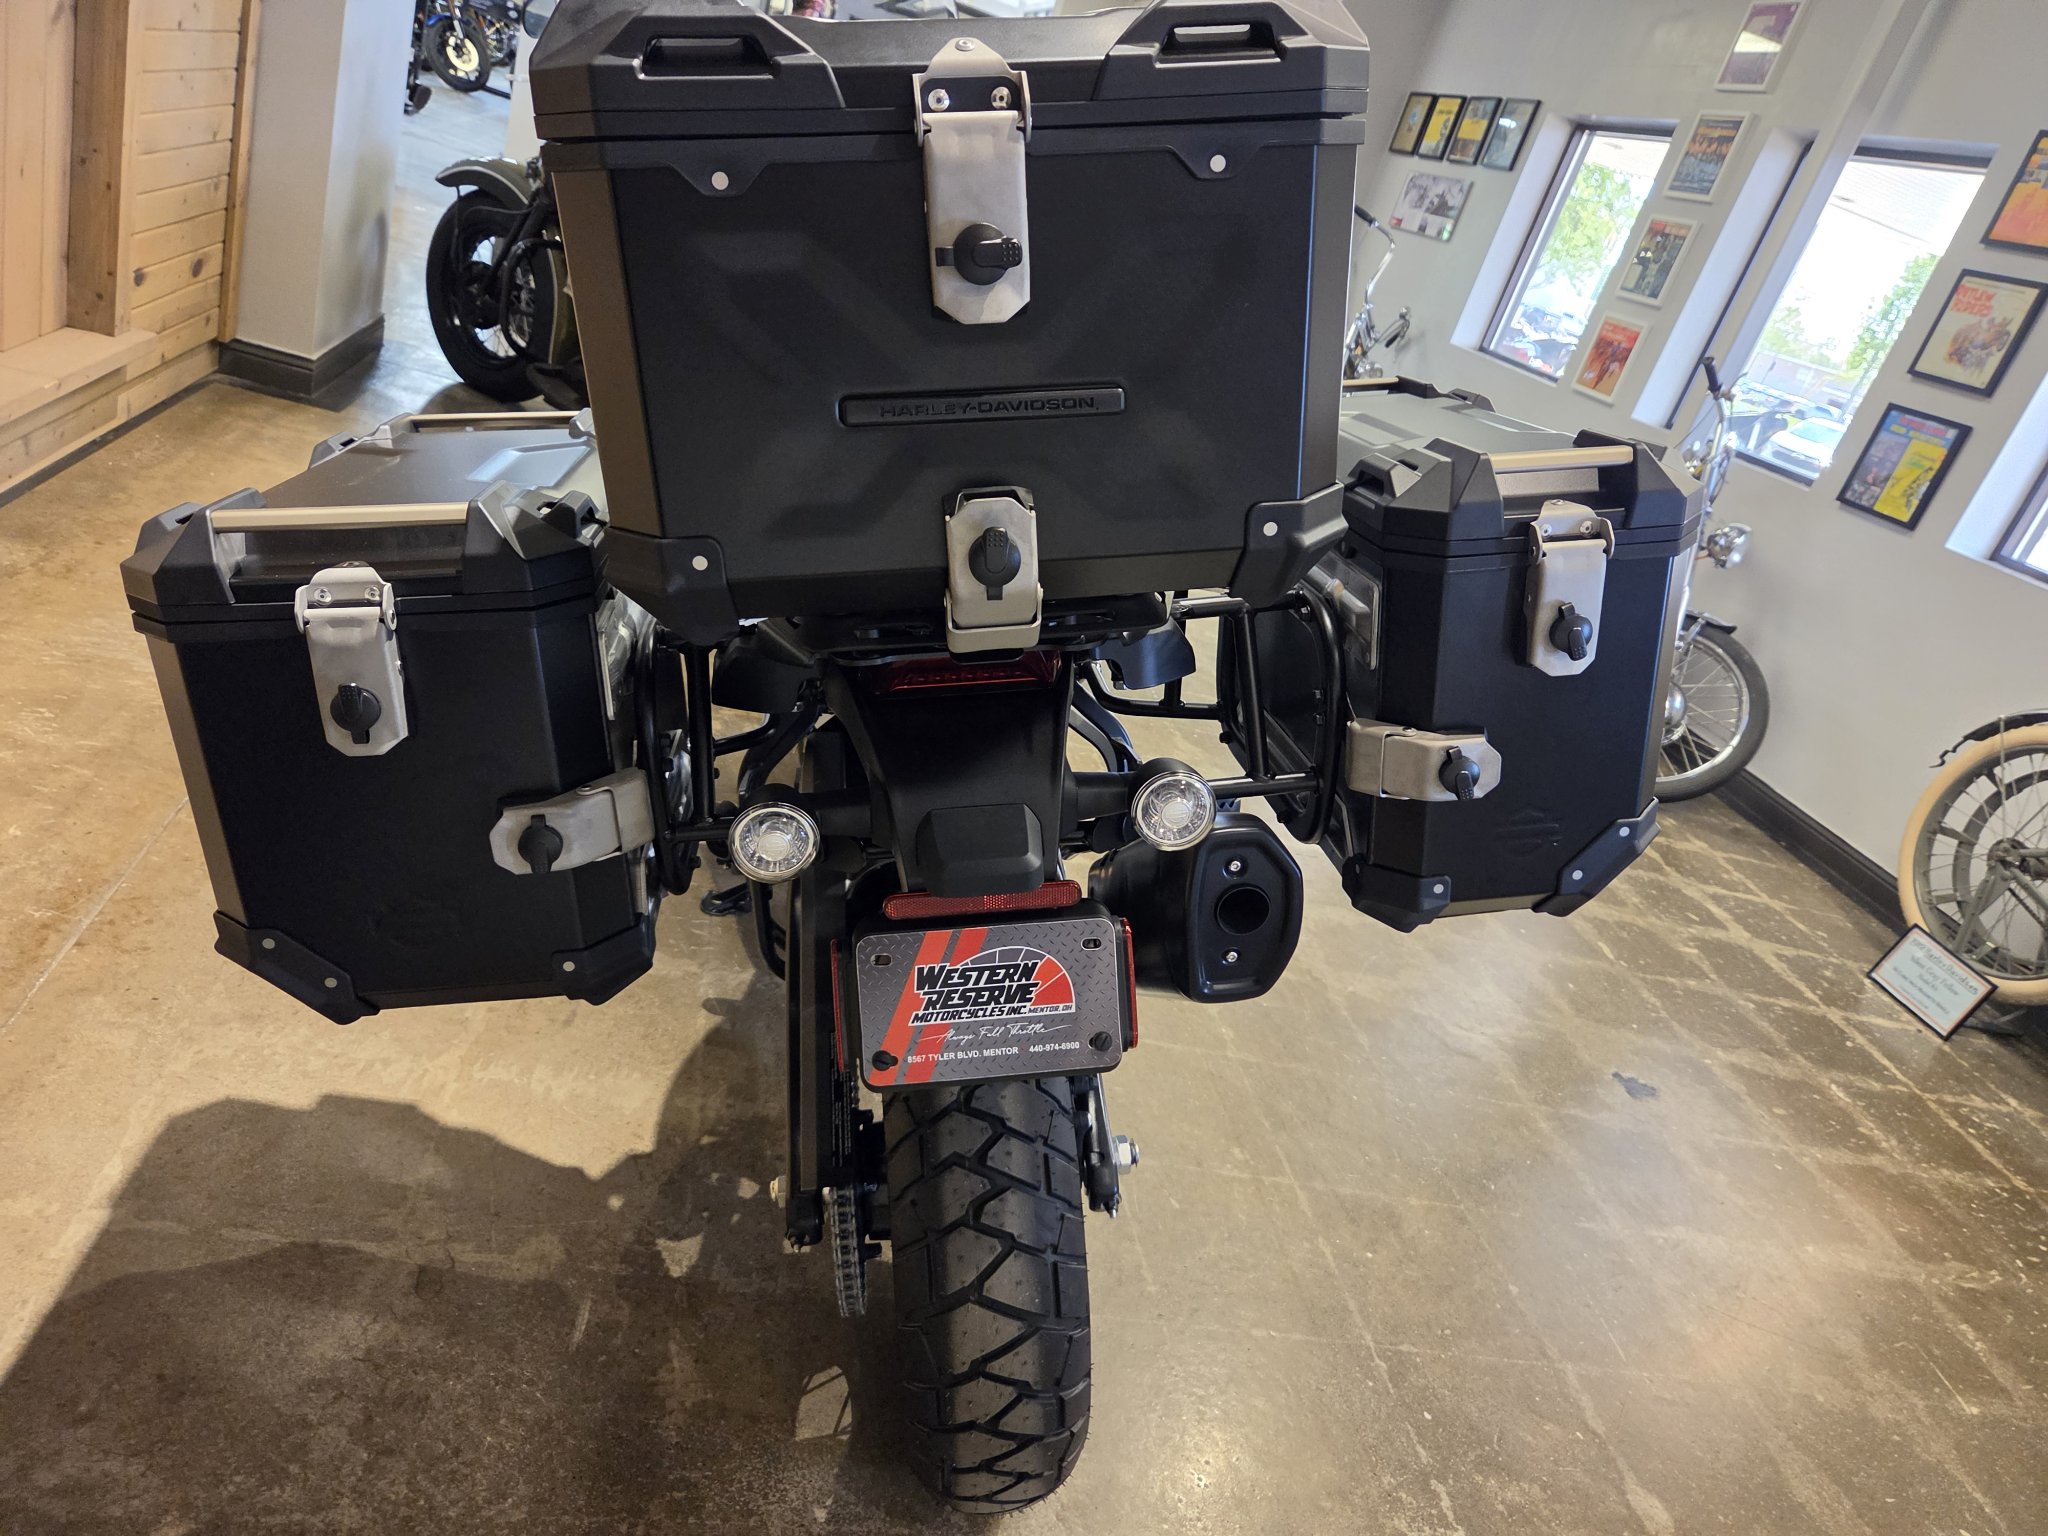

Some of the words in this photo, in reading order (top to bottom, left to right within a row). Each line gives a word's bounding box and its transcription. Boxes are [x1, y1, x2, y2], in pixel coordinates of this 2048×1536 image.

[880, 397, 1095, 417] HARLEY-DAVIDSON
[915, 961, 1041, 992] WESTERN
[921, 981, 1041, 1011] RESERVE
[911, 1006, 1005, 1024] MOTORCYCLES
[1005, 1005, 1027, 1016] INC.
[920, 1029, 975, 1045] Always
[979, 1026, 1005, 1039] Full
[1007, 1022, 1072, 1037] Throttle
[907, 1055, 926, 1064] 8567
[928, 1052, 956, 1062] TYLER
[957, 1050, 982, 1059] BLVD.
[983, 1046, 1019, 1057] MENTOR
